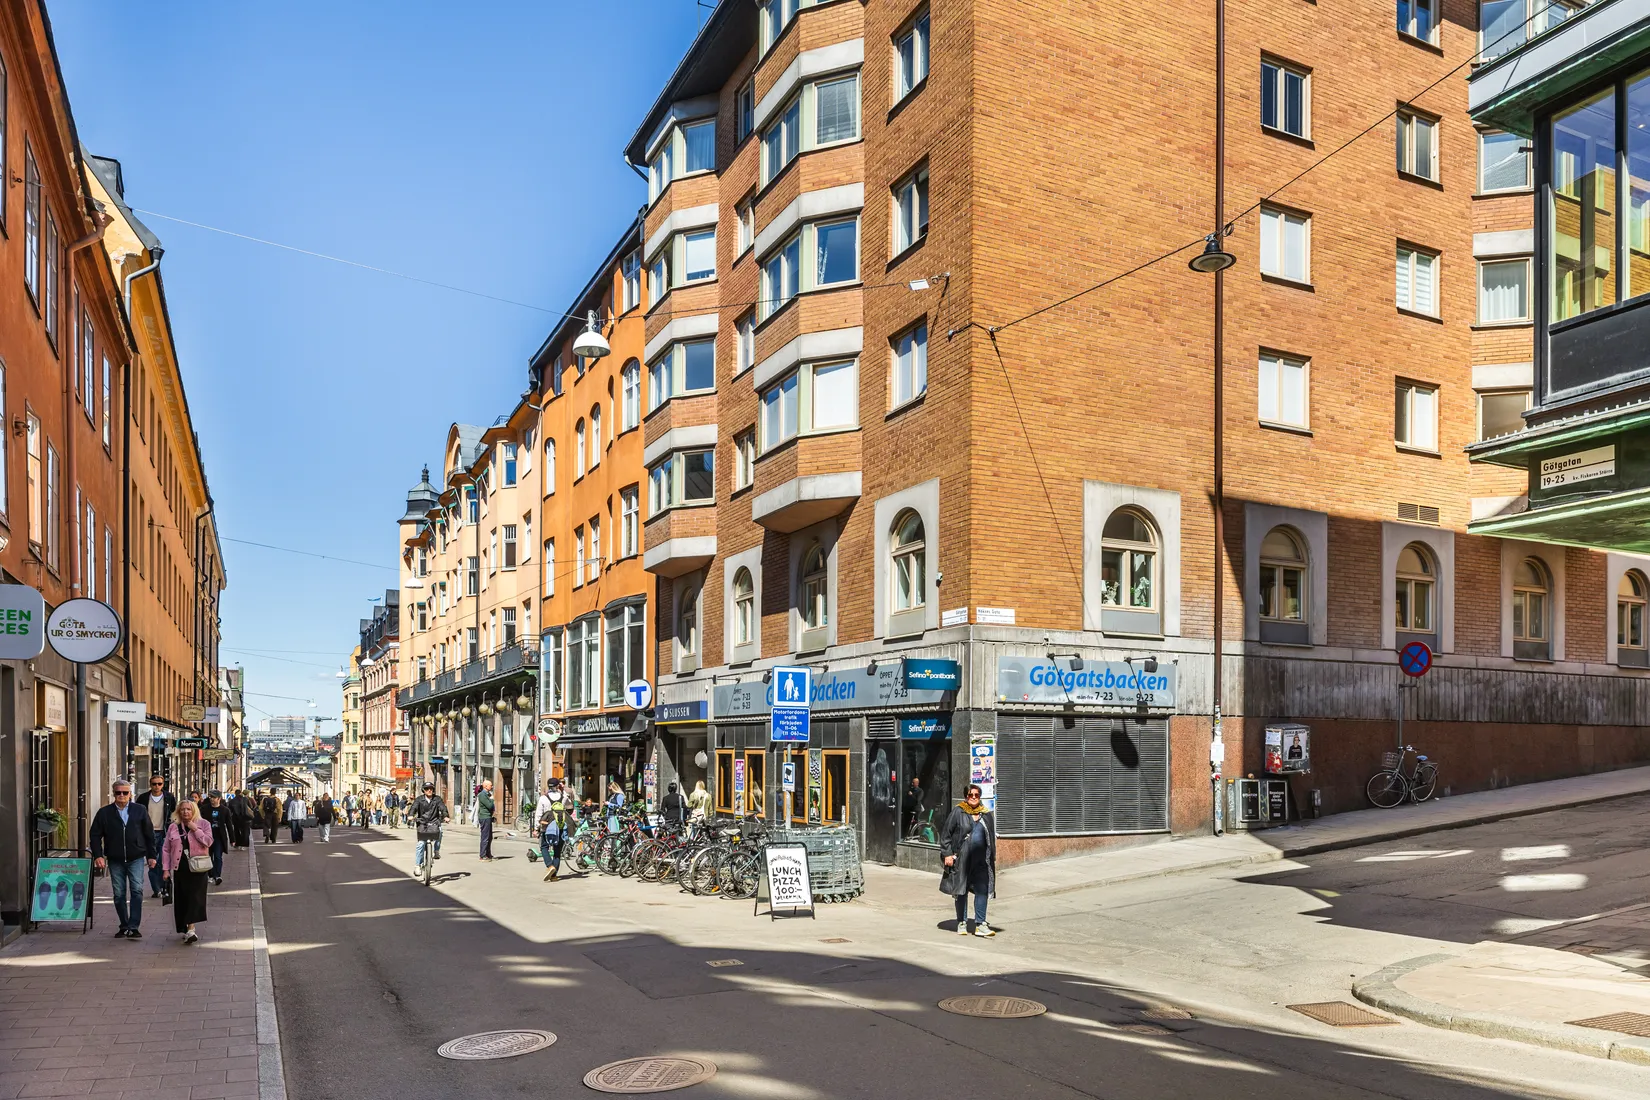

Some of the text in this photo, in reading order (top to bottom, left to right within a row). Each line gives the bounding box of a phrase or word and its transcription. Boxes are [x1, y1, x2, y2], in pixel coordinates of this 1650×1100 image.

[1543, 457, 1582, 472] Götgatan
[1543, 474, 1565, 486] 19-25
[51, 629, 64, 637] UR
[76, 630, 117, 638] SMYCKEN
[880, 671, 893, 679] ÖPPET
[1029, 665, 1168, 692] Götgatsbacken
[895, 677, 904, 687] 7-2
[630, 686, 646, 706] T
[894, 688, 908, 698] 9-23
[1095, 692, 1113, 700] 7-23
[1136, 694, 1154, 702] 9-23
[669, 706, 690, 718] SLUSSEN
[925, 724, 946, 733] pantbank
[772, 866, 802, 877] LUNCH
[772, 877, 801, 886] PIZZA
